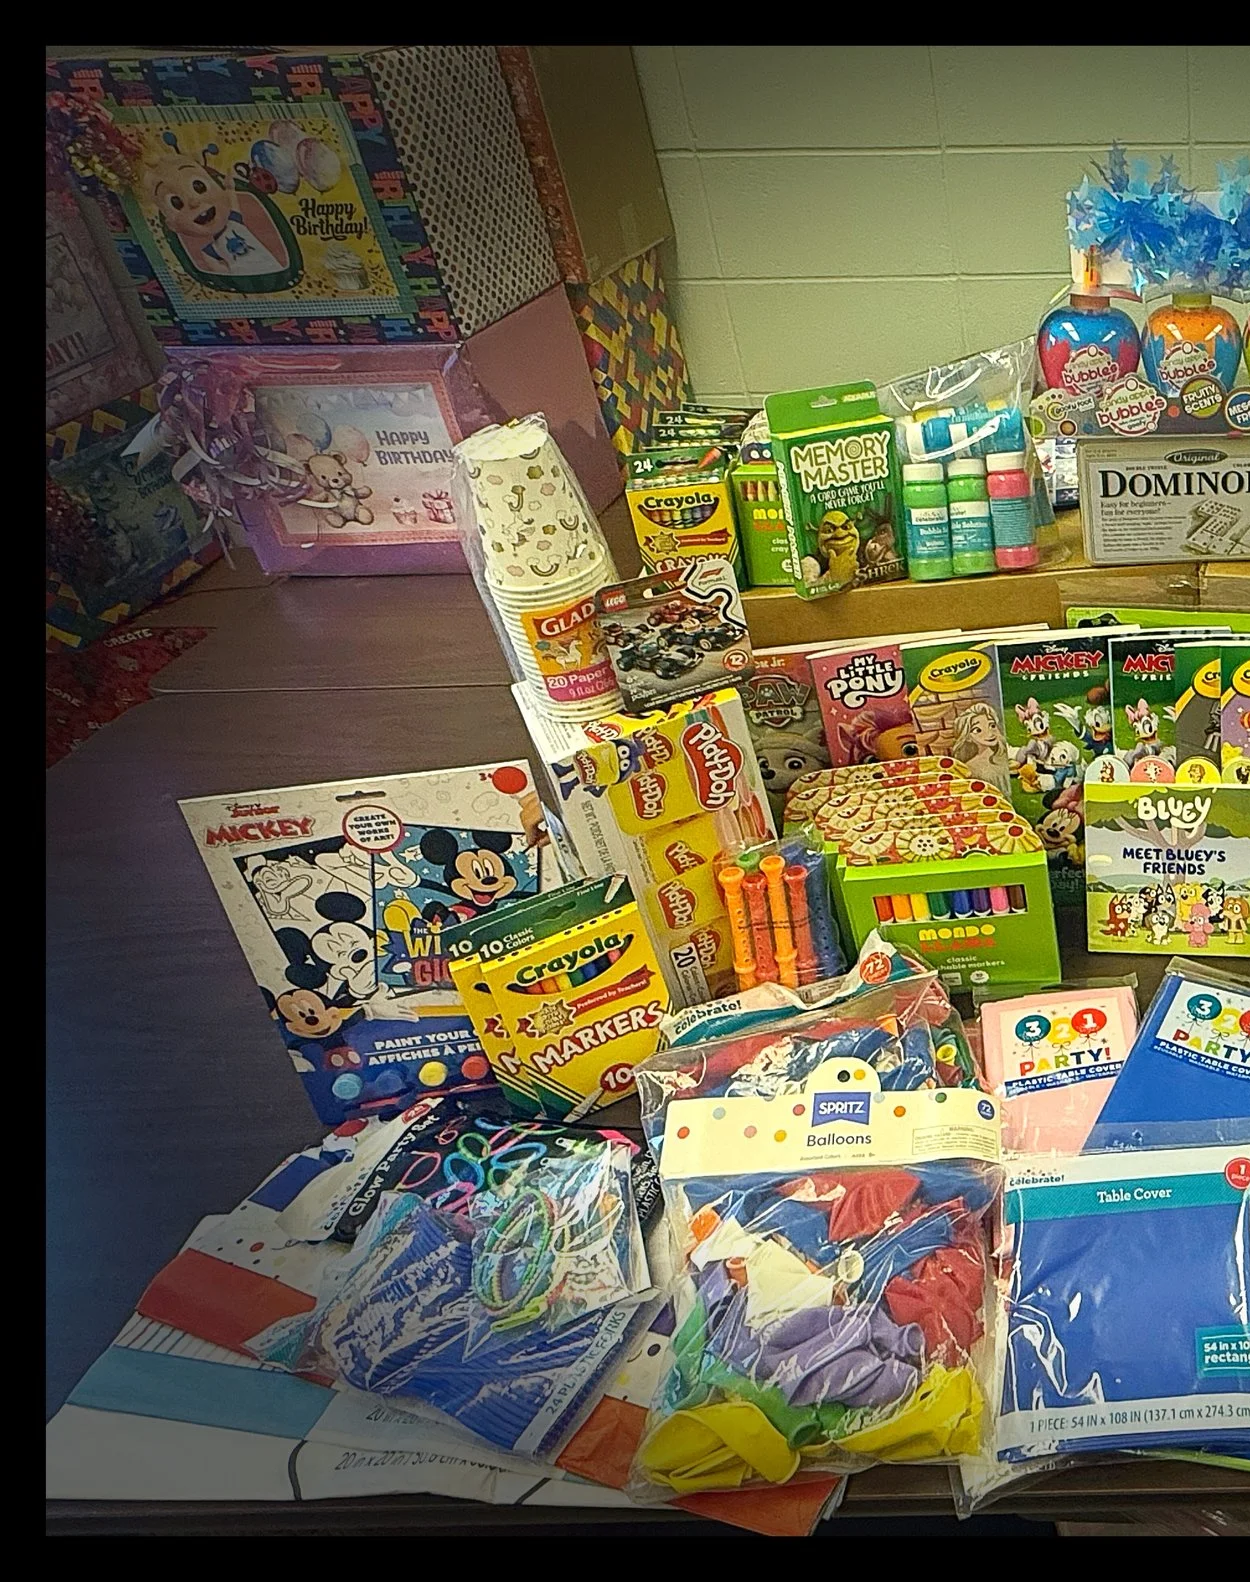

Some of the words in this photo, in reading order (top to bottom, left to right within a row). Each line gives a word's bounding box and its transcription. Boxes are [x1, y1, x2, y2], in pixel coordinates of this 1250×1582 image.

[299, 198, 357, 221] Happy
[290, 216, 368, 241] Birthday!
[1183, 385, 1215, 402] FRUITY
[1184, 395, 1222, 414] SCENTS
[666, 416, 682, 424] 24
[375, 430, 430, 448] HAPPY
[659, 428, 676, 437] 24
[792, 432, 888, 473] MEMORY
[1172, 451, 1221, 464] Original
[634, 459, 653, 473] 24
[803, 456, 888, 490] MASTER
[644, 492, 713, 510] Crayola
[811, 495, 816, 504] A
[817, 490, 837, 502] CARD
[839, 486, 860, 498] GAME
[825, 498, 847, 510] NEVER
[848, 491, 874, 506] FORGET
[540, 600, 595, 636] GLAD
[103, 629, 153, 648] CREATE
[854, 655, 874, 667] MY
[930, 658, 977, 678] Crayola
[1011, 651, 1104, 673] MICKEY
[549, 677, 567, 689] 20
[568, 667, 608, 686] Paper
[741, 682, 811, 709] PAW
[827, 671, 902, 708] PONY
[756, 709, 797, 719] PATROL
[688, 722, 736, 806] Play-Doh
[348, 822, 372, 830] YOUR
[375, 820, 396, 828] OWN
[354, 814, 386, 822] CREATE
[1136, 797, 1212, 836] BLUEY
[206, 817, 314, 846] MICKEY
[373, 834, 394, 843] ART!
[1122, 847, 1162, 862] MEET
[1165, 849, 1226, 863] BLUEY'S
[1143, 862, 1205, 875] FRIENDS
[450, 939, 472, 957] 10
[481, 940, 505, 959] 10
[504, 927, 533, 943] Classic
[505, 935, 535, 950] Colors
[516, 933, 623, 985] Crayola
[946, 955, 977, 964] classic
[968, 960, 1006, 969] markers
[674, 999, 742, 1035] celebrate!
[1198, 1000, 1213, 1016] 3
[1222, 1014, 1236, 1029] 2
[1025, 1021, 1041, 1037] 3
[1055, 1023, 1070, 1039] 2
[1082, 1014, 1096, 1029] 1
[374, 1035, 422, 1051] PAINT
[428, 1030, 470, 1043] YOUR
[531, 1001, 665, 1074] MARKERS
[369, 1048, 440, 1067] AFFICHES
[1020, 1047, 1111, 1077] PARTY!
[1159, 1041, 1198, 1060] PLASTIC
[1199, 1056, 1229, 1071] TABLE
[604, 1066, 633, 1090] 10
[1012, 1076, 1053, 1089] PLASTIC
[1056, 1068, 1087, 1081] TABLE
[1089, 1063, 1122, 1075] COVER
[819, 1101, 866, 1115] SPRITZ
[807, 1133, 872, 1147] Balloons
[349, 1175, 386, 1217] Glow
[376, 1132, 416, 1173] Party
[412, 1115, 440, 1132] Set
[1239, 1163, 1246, 1175] 1
[1009, 1174, 1064, 1188] celebrate!
[1097, 1188, 1131, 1203] Table
[1133, 1185, 1172, 1202] Cover
[1203, 1343, 1216, 1353] 54
[1218, 1341, 1228, 1351] in
[1230, 1342, 1237, 1350] x
[546, 1397, 563, 1415] 24
[560, 1349, 598, 1400] PLASTIC
[596, 1310, 626, 1349] FORKS
[1031, 1421, 1035, 1432] 1
[1038, 1418, 1068, 1432] PIECE:
[1072, 1416, 1084, 1430] 54
[1086, 1414, 1098, 1427] IN
[1100, 1416, 1106, 1426] x
[1109, 1413, 1128, 1425] 108
[1130, 1411, 1141, 1423] IN
[1143, 1408, 1176, 1424] (137.1
[1179, 1408, 1195, 1419] cm
[1196, 1408, 1203, 1418] x
[1205, 1404, 1234, 1418] 274.3
